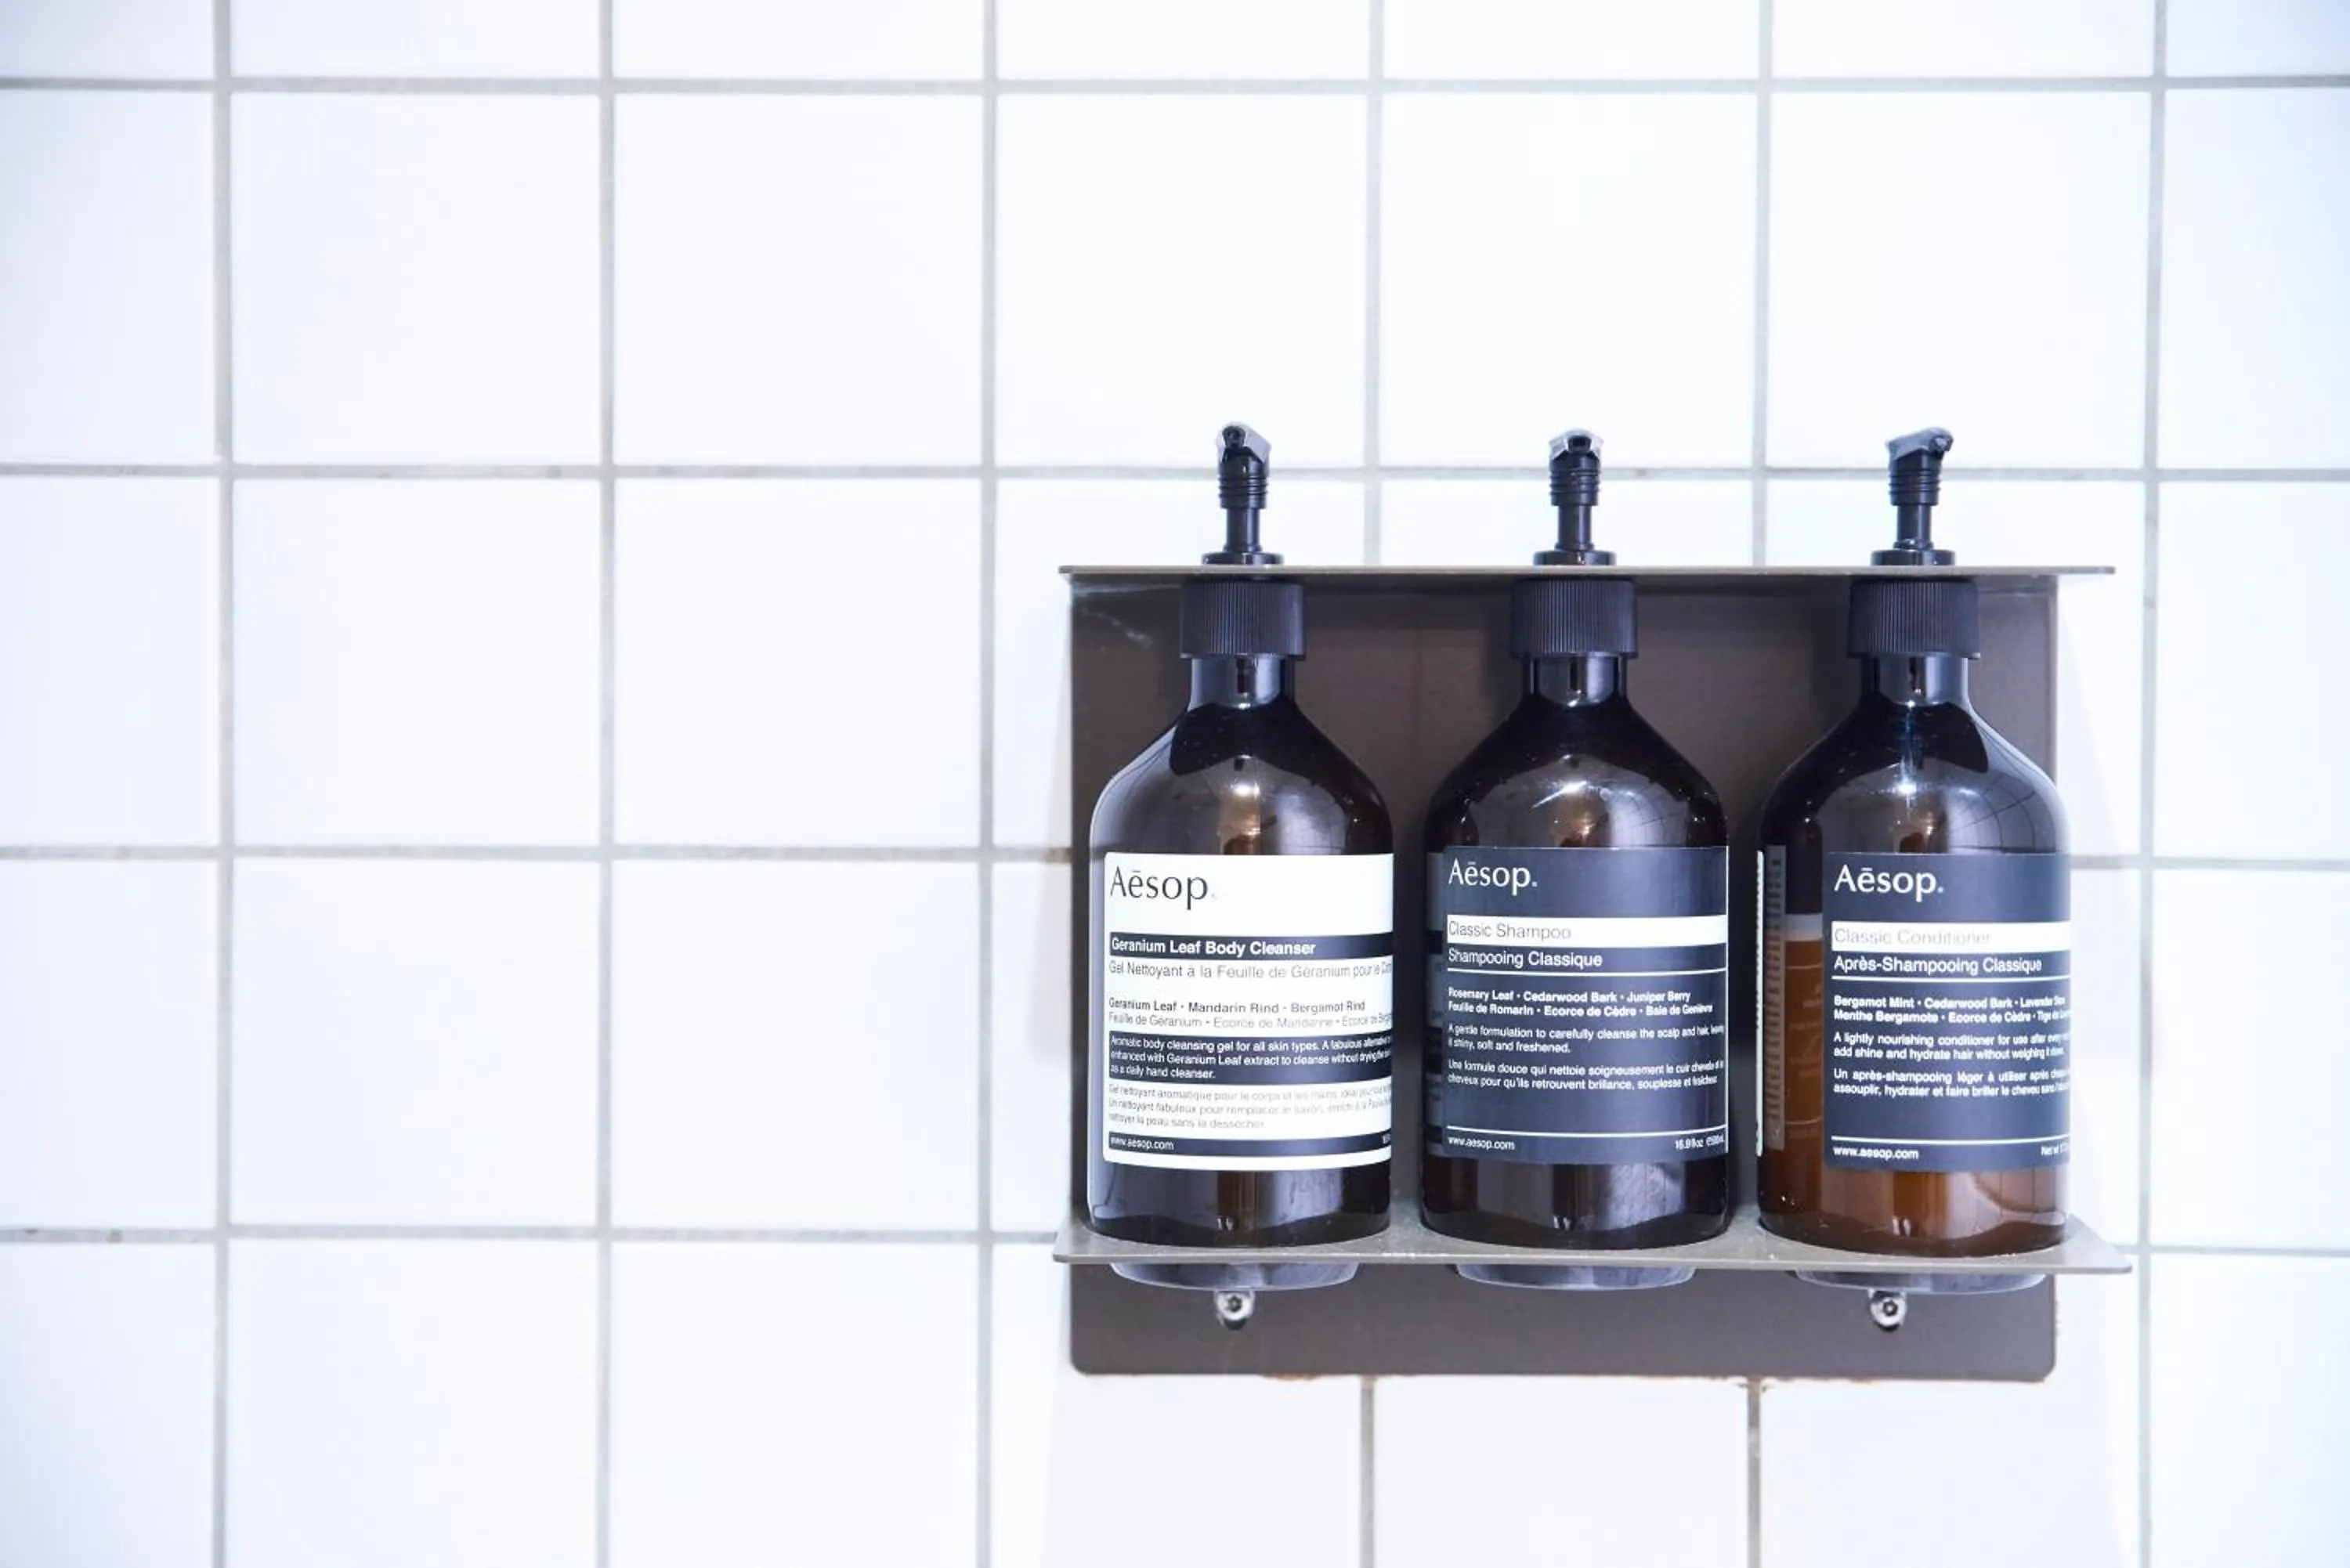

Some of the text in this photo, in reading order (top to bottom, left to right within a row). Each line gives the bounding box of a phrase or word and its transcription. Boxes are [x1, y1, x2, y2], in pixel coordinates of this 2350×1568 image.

[1449, 920, 1571, 941] Classic Shampoo
[1835, 927, 1990, 945] Classic Conditioner
[1112, 937, 1317, 958] Geranium Leaf Body Cleanser
[1448, 947, 1603, 970] Shampooing Classique
[1834, 955, 2042, 977] Après-Shampooing Classique
[1109, 959, 1124, 976] Gel
[1127, 962, 1182, 980] Nettoyant
[1200, 964, 1212, 978] la
[1217, 964, 1264, 979] Feuille
[1268, 966, 1286, 978] de
[1448, 986, 1690, 1004] Rosemary Leaf Cedarwood Bark Juniper Berry
[1834, 994, 1886, 1010] Bergamot
[1889, 995, 1914, 1008] Mint
[1924, 996, 1987, 1010] Cedarwood
[1990, 996, 2012, 1009] Bark
[1109, 997, 1365, 1016] Geranium Leaf Mandarin Rind Bergamot Rind
[1448, 1000, 1473, 1013] Feuille
[1475, 1003, 1488, 1014] de
[1489, 1003, 1534, 1016] Romarin
[1544, 1005, 1584, 1017] Ecorce
[1586, 1006, 1602, 1017] de
[1646, 1005, 1668, 1016] Baie
[1668, 1003, 1681, 1016] de
[1135, 1014, 1147, 1025] de
[1834, 1008, 1873, 1021] Menthe
[1875, 1010, 1938, 1024] Bergamote
[1948, 1011, 1987, 1024] Ecorce
[1989, 1011, 2002, 1024] de
[1480, 1025, 1533, 1038] formulation
[1535, 1027, 1546, 1038] to
[1549, 1028, 1593, 1042] carefully
[1596, 1028, 1637, 1039] cleanse
[1640, 1028, 1654, 1039] the
[1657, 1028, 1680, 1040] scalp
[1682, 1026, 1695, 1038] and
[1834, 1031, 1841, 1042] A
[1844, 1031, 1874, 1046] lightly
[1878, 1034, 1934, 1048] nourishing
[1937, 1034, 1994, 1046] conditioner
[1998, 1034, 2010, 1046] for
[2012, 1035, 2028, 1044] use
[1143, 1037, 1165, 1052] body
[1166, 1040, 1214, 1053] cleansing
[1217, 1041, 1234, 1053] gel
[1236, 1040, 1251, 1052] for
[1253, 1040, 1266, 1052] all
[1268, 1040, 1289, 1052] skin
[1321, 1040, 1329, 1050] A
[1331, 1039, 1362, 1050] fabulous
[1477, 1040, 1493, 1050] soft
[1495, 1041, 1514, 1051] and
[1516, 1041, 1571, 1053] freshened.
[1148, 1051, 1165, 1064] with
[1166, 1053, 1216, 1064] Geranium
[1218, 1054, 1242, 1065] Leaf
[1243, 1055, 1279, 1066] extract
[1281, 1055, 1292, 1066] to
[1293, 1054, 1329, 1066] cleanse
[1331, 1052, 1358, 1064] without
[1834, 1046, 1852, 1057] add
[1854, 1047, 1883, 1058] shine
[1885, 1048, 1907, 1059] and
[1909, 1048, 1950, 1063] hydrate
[1953, 1048, 1972, 1060] hair
[1975, 1049, 2010, 1060] without
[2012, 1047, 2045, 1061] weighing
[1146, 1066, 1168, 1077] hand
[1170, 1067, 1216, 1078] cleanser.
[1464, 1060, 1495, 1072] formule
[1497, 1063, 1528, 1074] douce
[1530, 1064, 1547, 1077] qui
[1549, 1064, 1585, 1075] nettoie
[1588, 1064, 1665, 1078] soigneusement
[1666, 1063, 1674, 1075] le
[1676, 1062, 1690, 1074] cuir
[1834, 1068, 1848, 1079] Un
[1853, 1069, 1952, 1085] après-shampooing
[1998, 1071, 2026, 1082] utiliser
[1480, 1076, 1502, 1088] pour
[1531, 1078, 1585, 1089] retrouvent
[1588, 1078, 1635, 1091] brillance,
[1637, 1078, 1682, 1092] souplesse
[1884, 1084, 1930, 1098] hydrater
[1932, 1086, 1943, 1097] et
[1946, 1085, 1969, 1097] faire
[1972, 1085, 1999, 1097] briller
[2001, 1085, 2009, 1097] le
[1157, 1089, 1212, 1101] aromatique
[1199, 1105, 1224, 1116] pour
[1833, 1146, 1918, 1161] www.aesop.com
